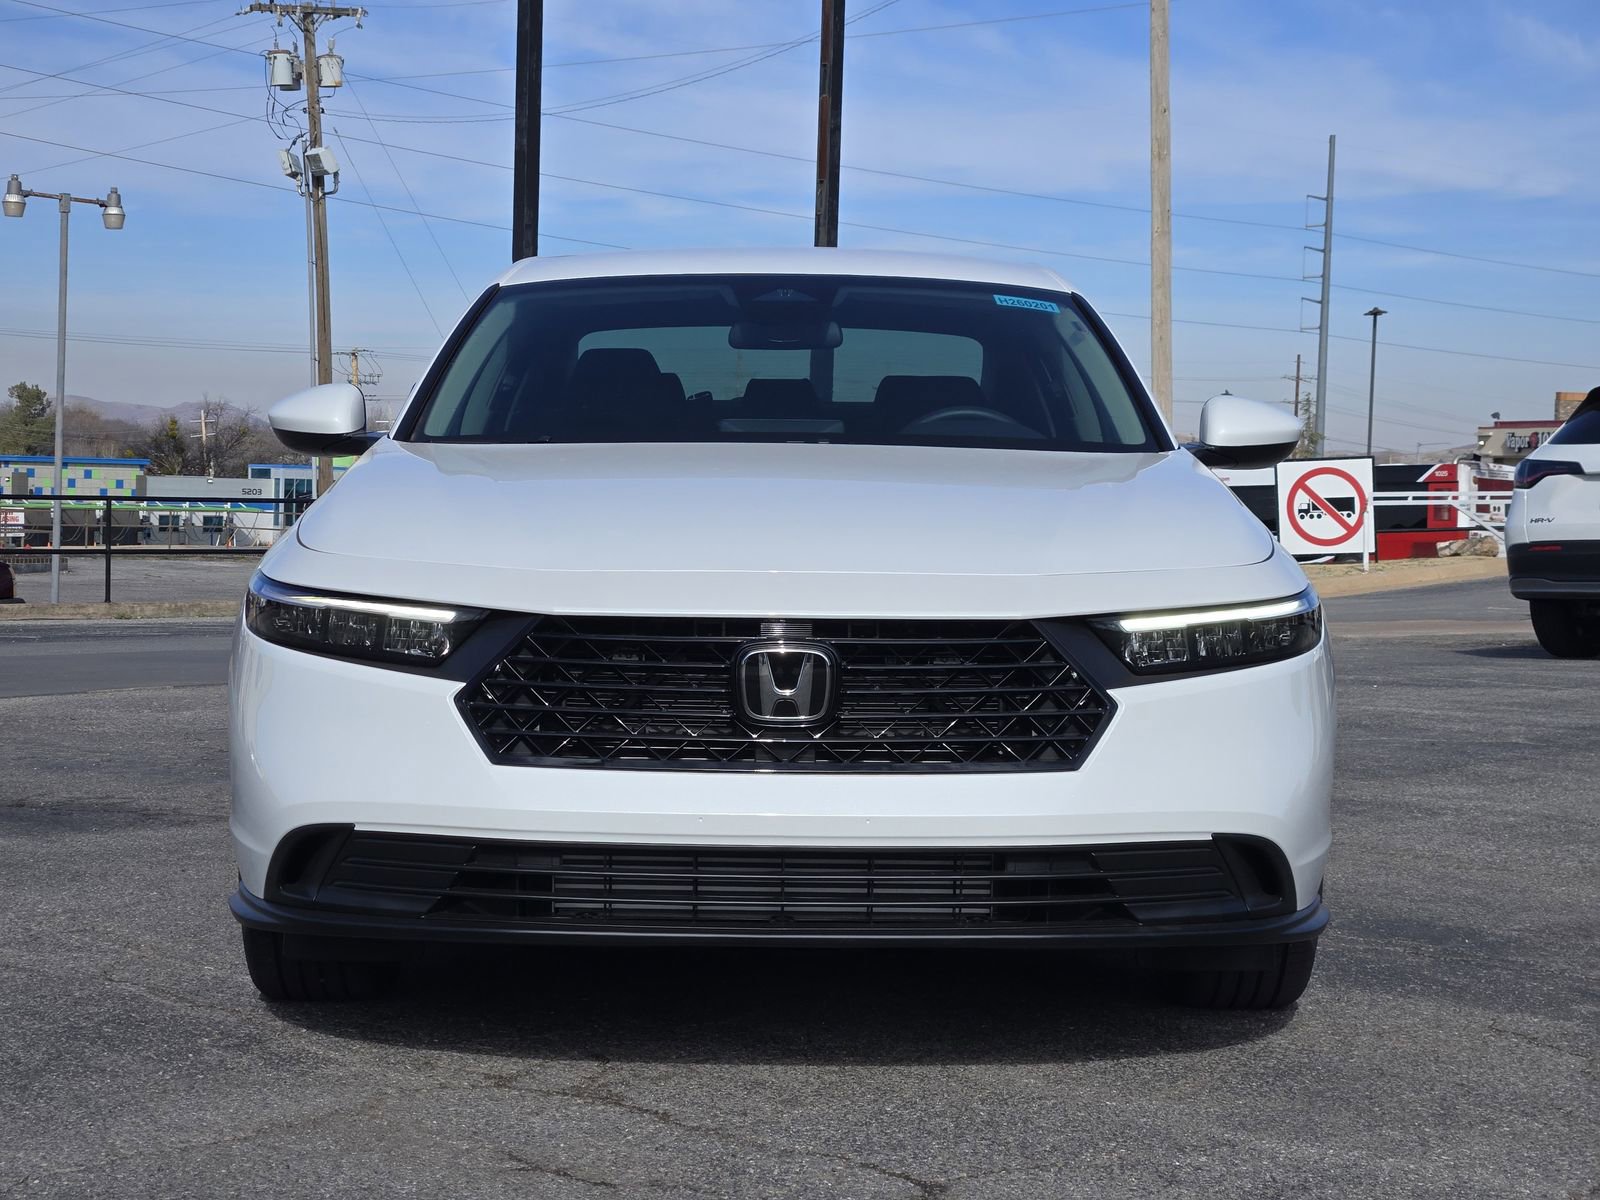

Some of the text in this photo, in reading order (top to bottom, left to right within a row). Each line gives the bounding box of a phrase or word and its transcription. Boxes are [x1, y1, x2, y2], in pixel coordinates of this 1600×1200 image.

[997, 296, 1056, 312] H260201
[1506, 432, 1529, 453] Vapor
[241, 487, 263, 496] 5203
[1529, 516, 1556, 524] HR-V
